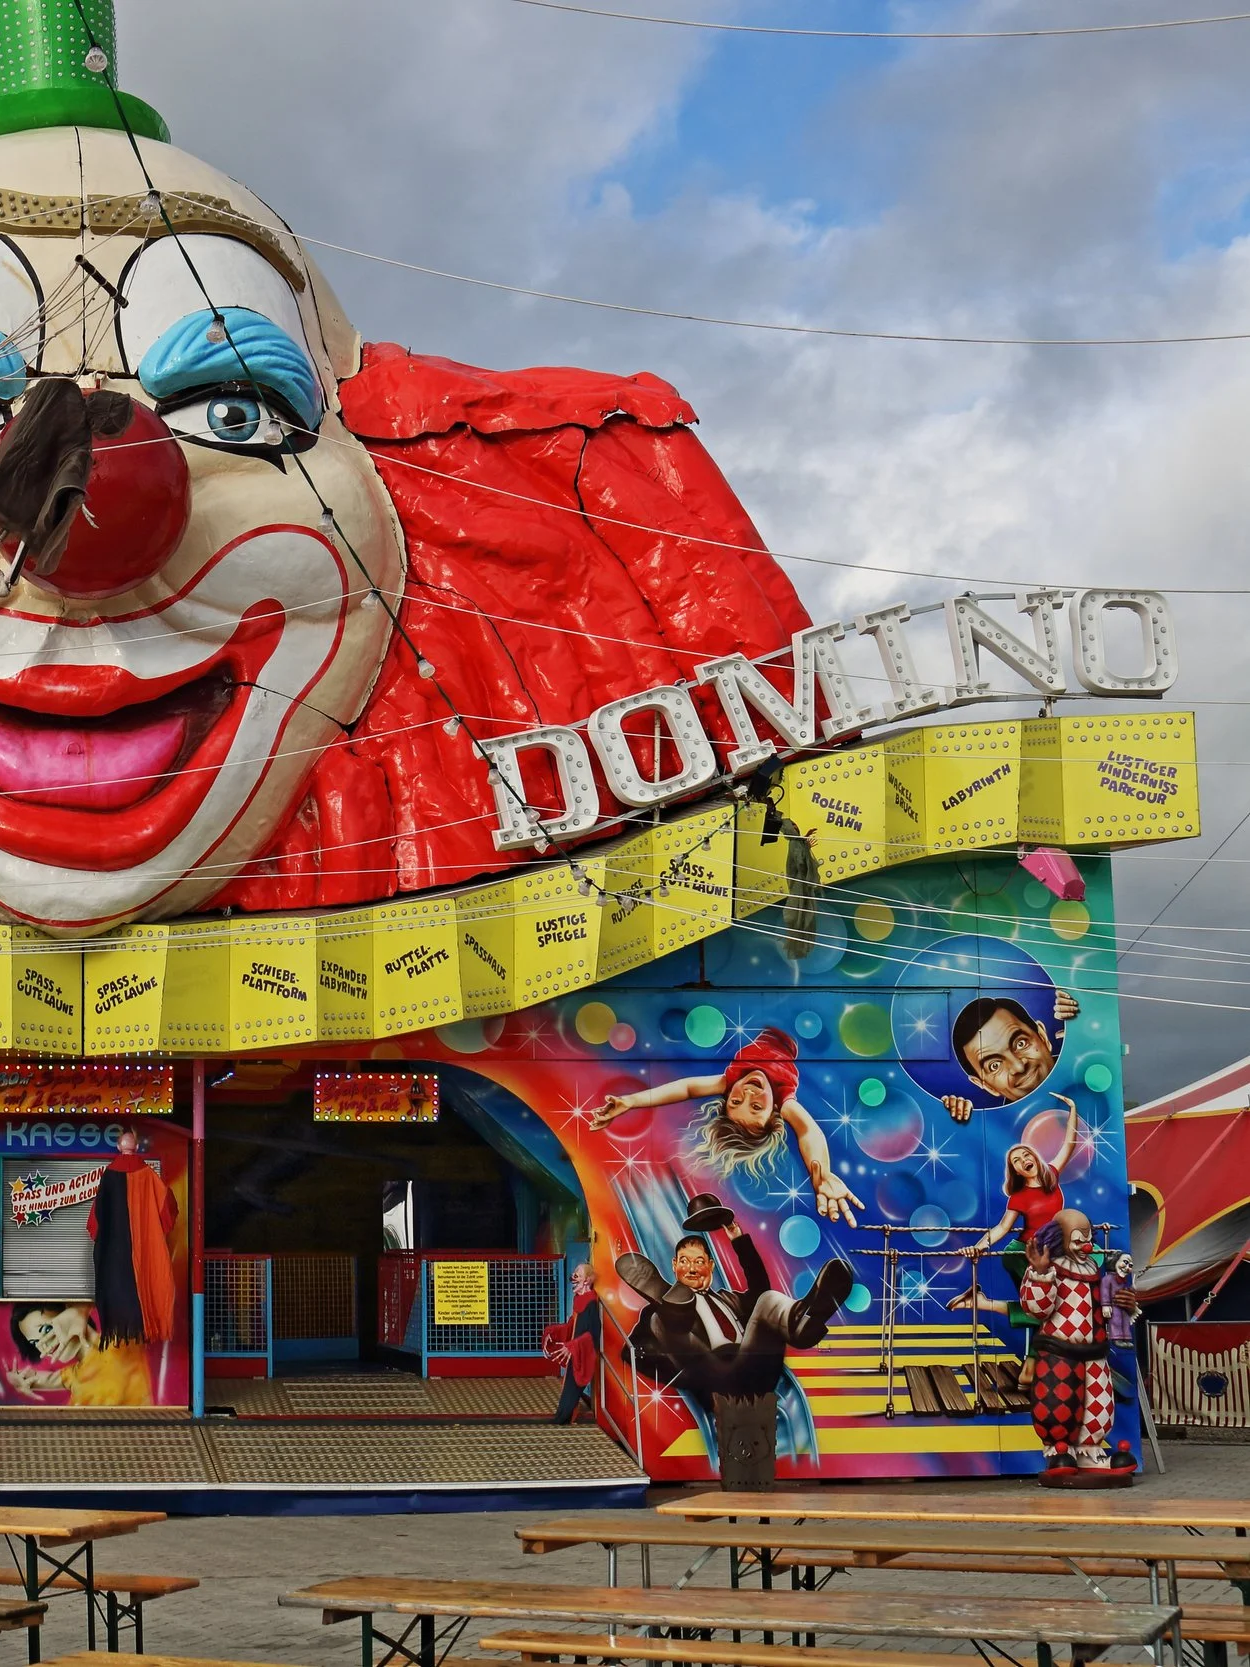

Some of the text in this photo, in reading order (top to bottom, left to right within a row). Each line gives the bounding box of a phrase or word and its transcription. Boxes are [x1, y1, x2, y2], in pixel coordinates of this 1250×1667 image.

[472, 588, 1179, 852] DOMINO
[1097, 761, 1178, 796] HINDERNISS
[1107, 750, 1178, 779] LUSTIGER
[887, 771, 913, 804] WACKEL
[941, 763, 1011, 811] LABYRINTH
[1099, 776, 1168, 805] PARKOUR
[811, 791, 863, 816] ROLLEN-
[825, 810, 863, 832] BAHN
[706, 871, 715, 880] +
[535, 912, 587, 933] LUSTIGE
[537, 927, 587, 948] SPIEGEL
[406, 949, 450, 979] PLATTE
[463, 932, 508, 981] SPASSHAUS
[24, 968, 63, 996] SPASS +
[96, 973, 139, 1000] SPASS +
[250, 961, 300, 985] SCHIEBE-
[319, 974, 368, 1000] LABYRINTH
[320, 960, 368, 986] EXPANDER
[16, 980, 74, 1016] GUTE LAUNE
[94, 976, 158, 1015] GUTE LAUNE
[241, 973, 308, 1002] PLATTFORM
[6, 1121, 125, 1147] KASSE
[12, 1165, 105, 1201] SPASS UND ACTION
[13, 1204, 26, 1213] BIS
[29, 1200, 58, 1211] HINAUF
[59, 1194, 77, 1206] ZUM
